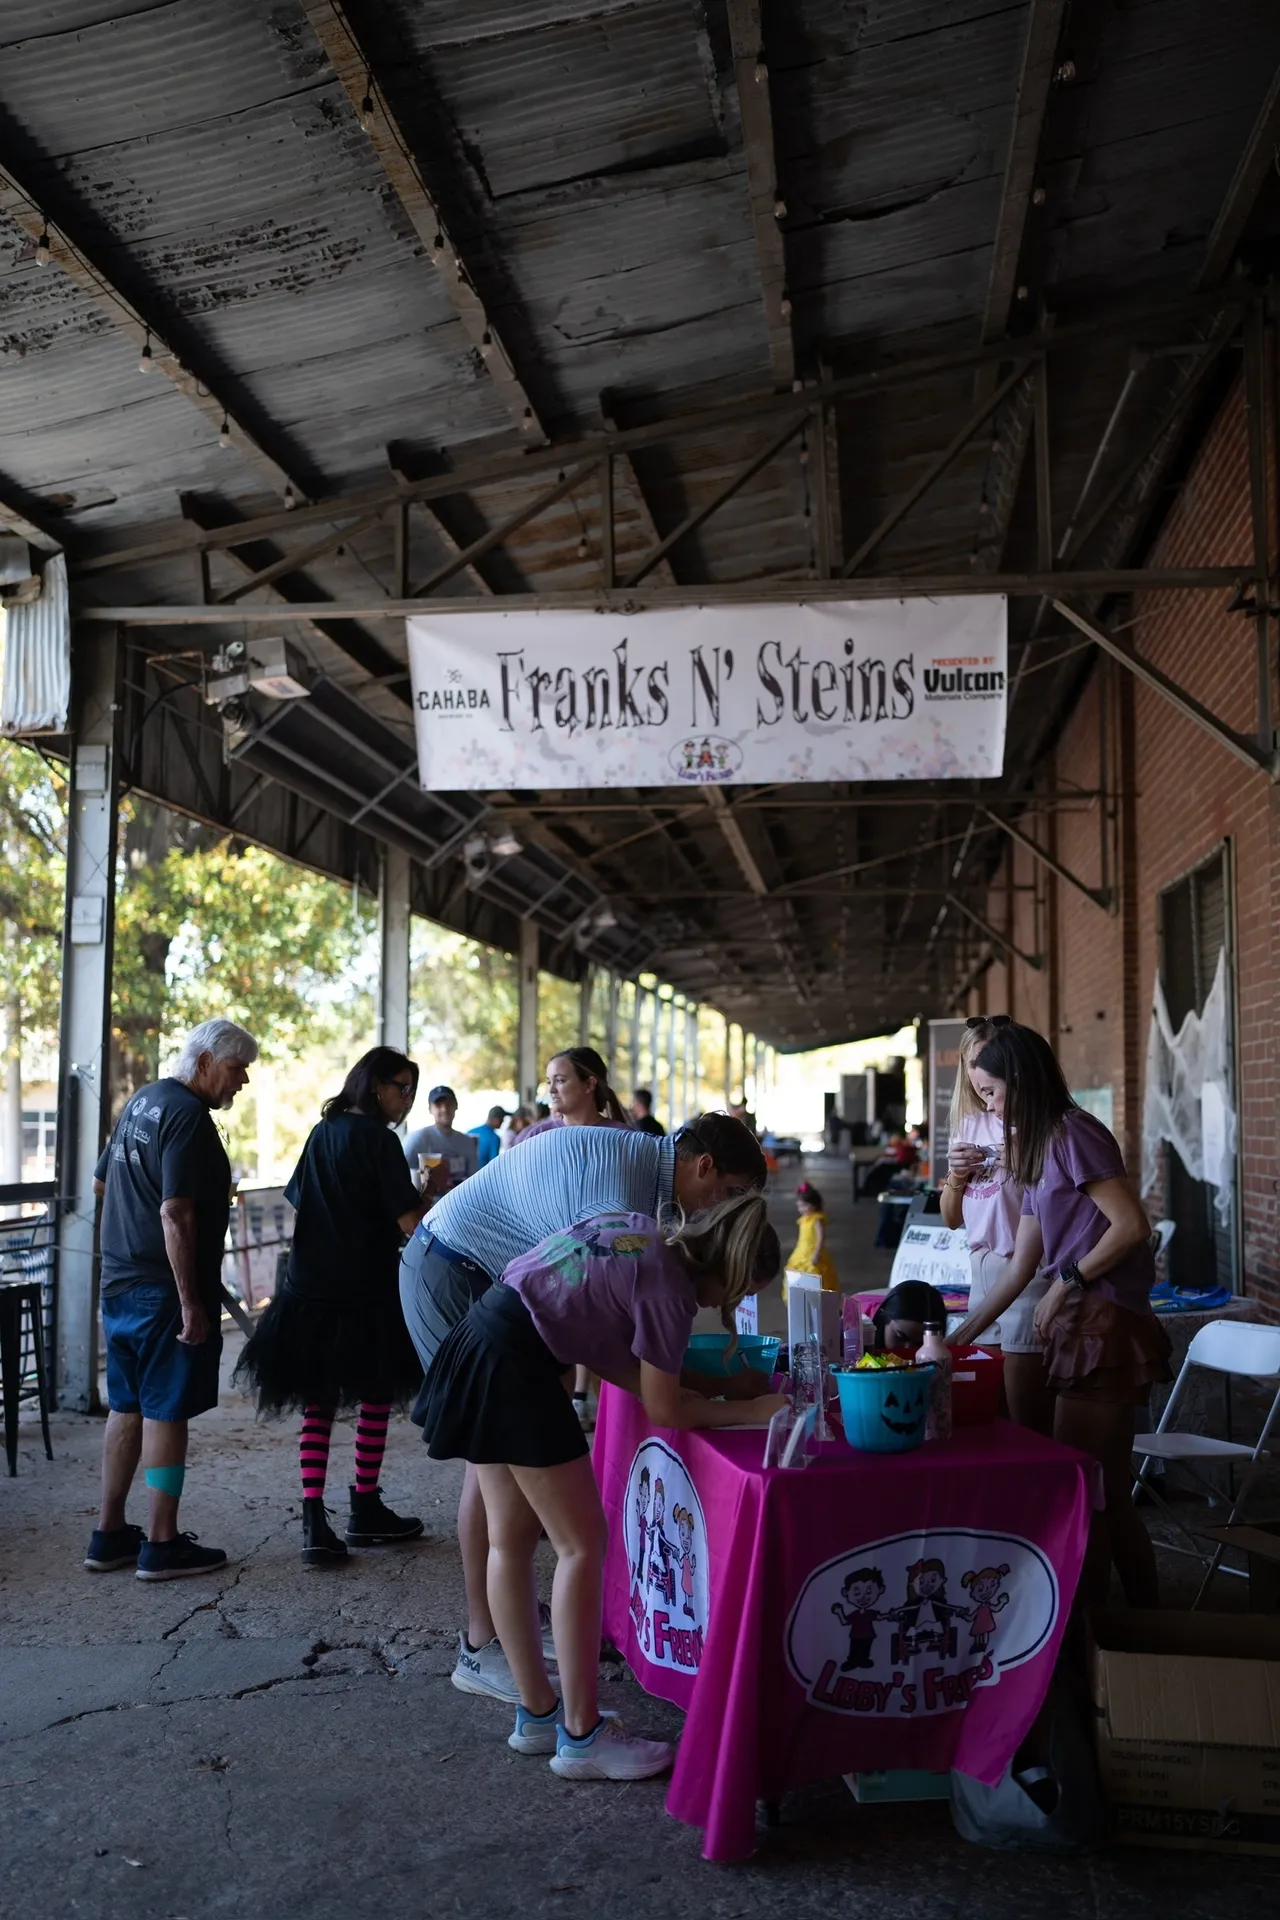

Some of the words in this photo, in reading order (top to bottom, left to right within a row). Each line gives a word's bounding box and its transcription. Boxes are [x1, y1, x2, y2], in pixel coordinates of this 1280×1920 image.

[497, 637, 670, 739] Franks
[757, 638, 914, 729] Steins
[923, 667, 1004, 692] Vulcan
[416, 689, 490, 710] CAHABA
[459, 1650, 481, 1675] HOKA
